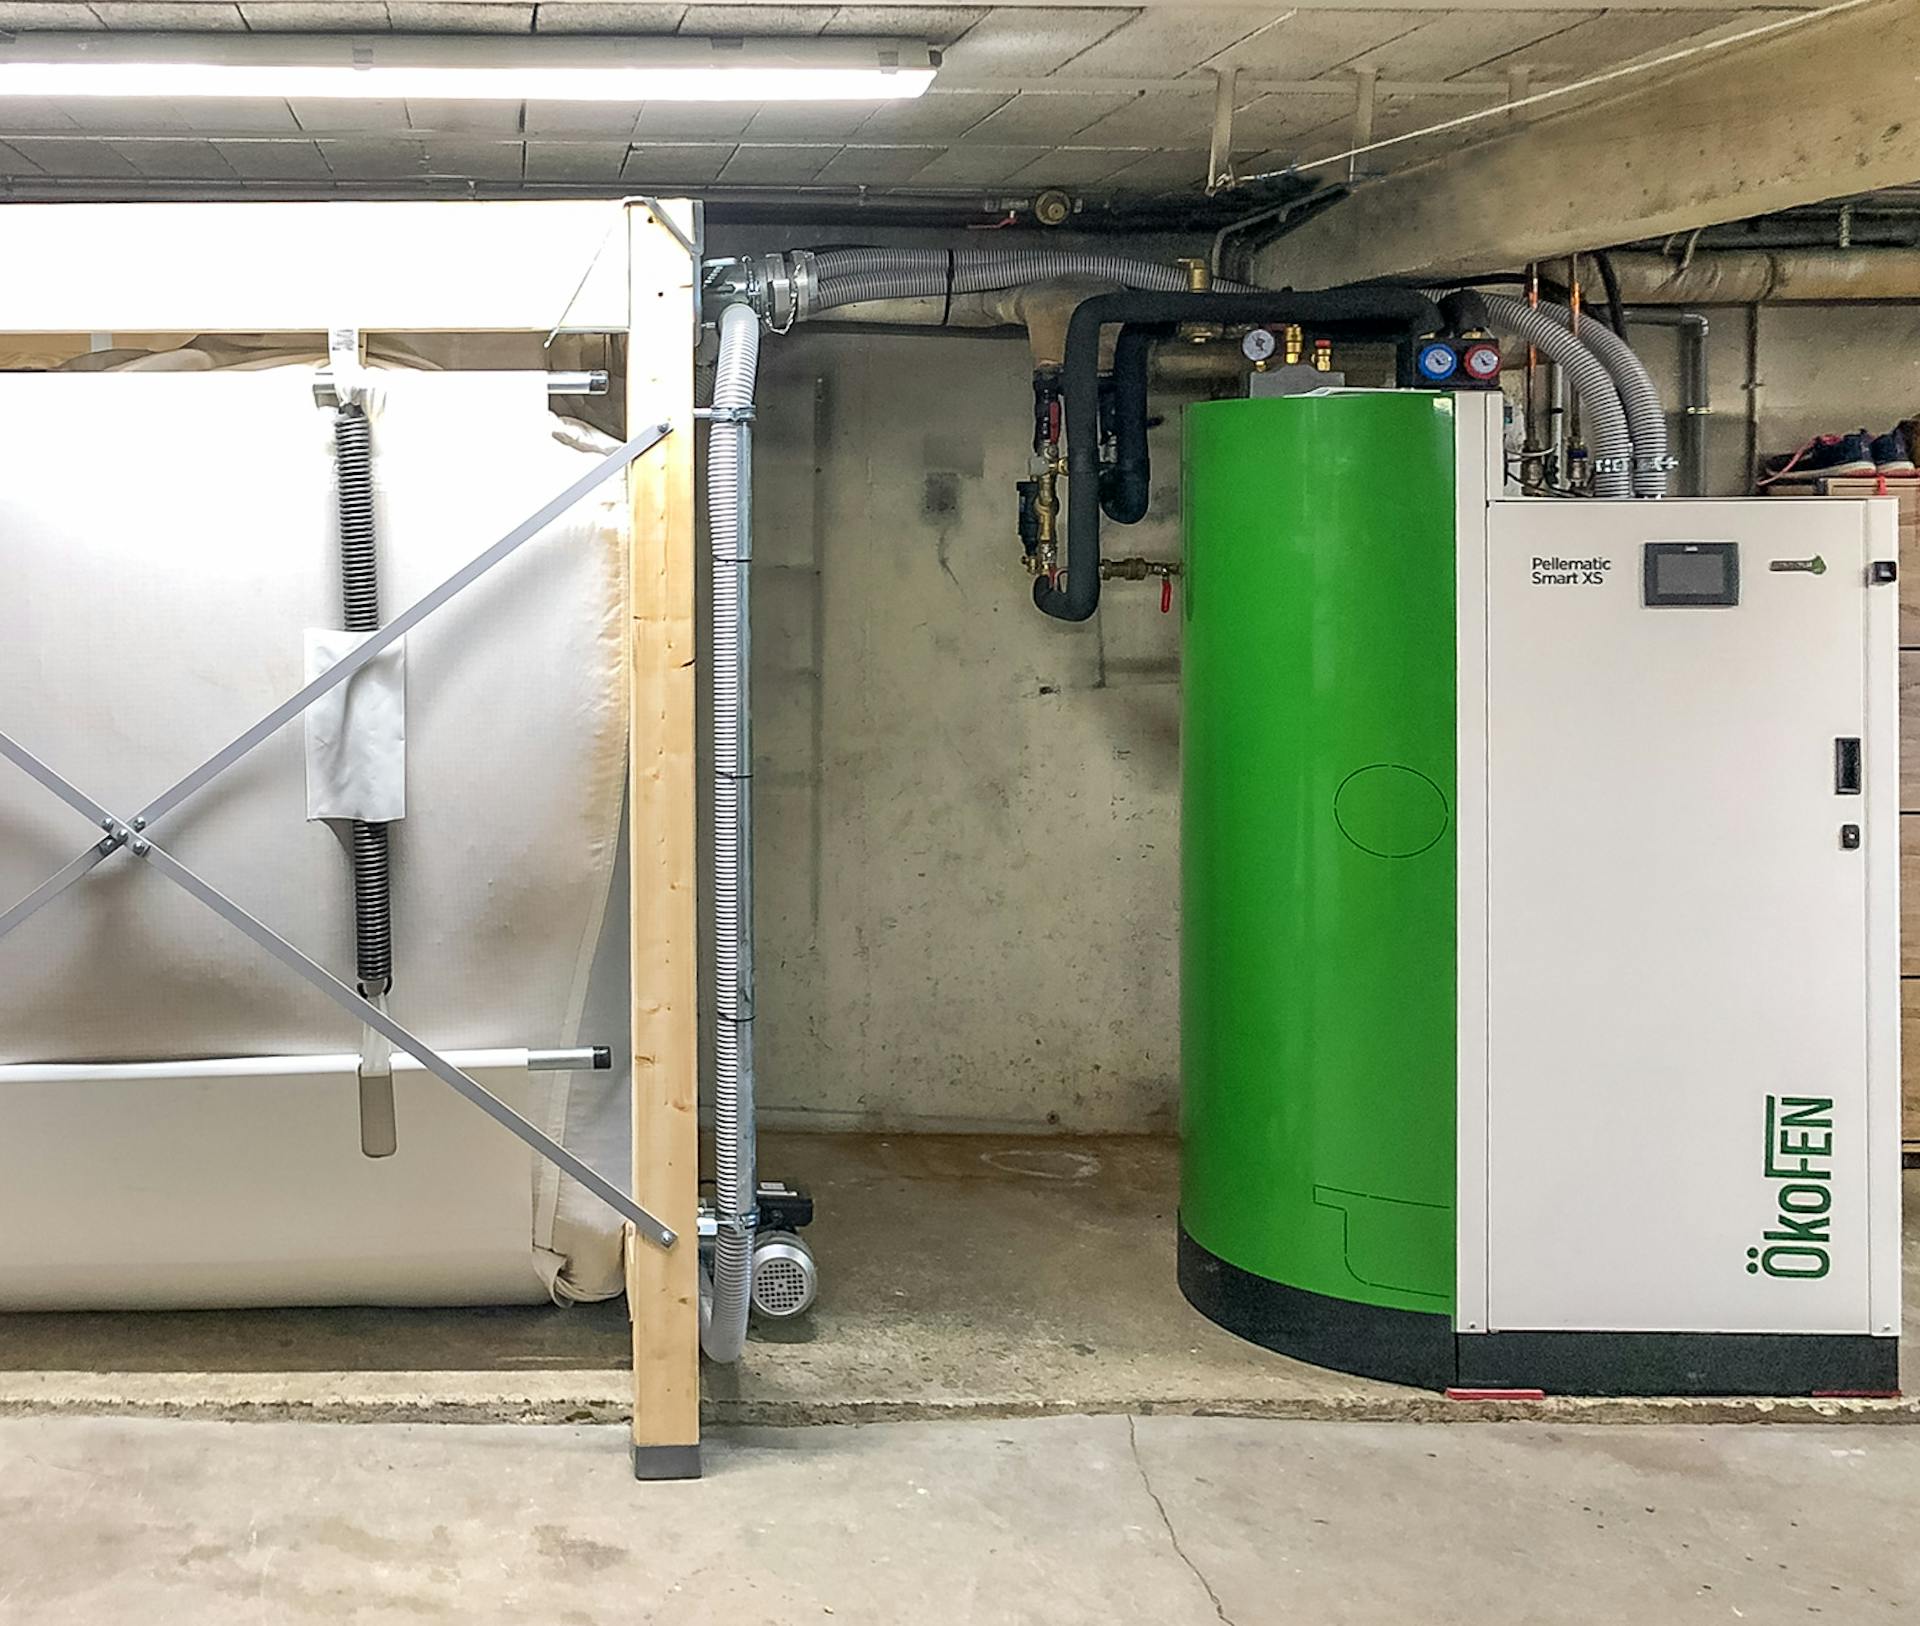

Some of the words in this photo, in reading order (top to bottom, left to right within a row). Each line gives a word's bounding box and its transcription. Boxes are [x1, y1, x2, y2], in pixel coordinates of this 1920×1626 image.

[1532, 557, 1611, 570] Pellematic
[1532, 571, 1578, 585] Smart
[1582, 571, 1604, 585] XS
